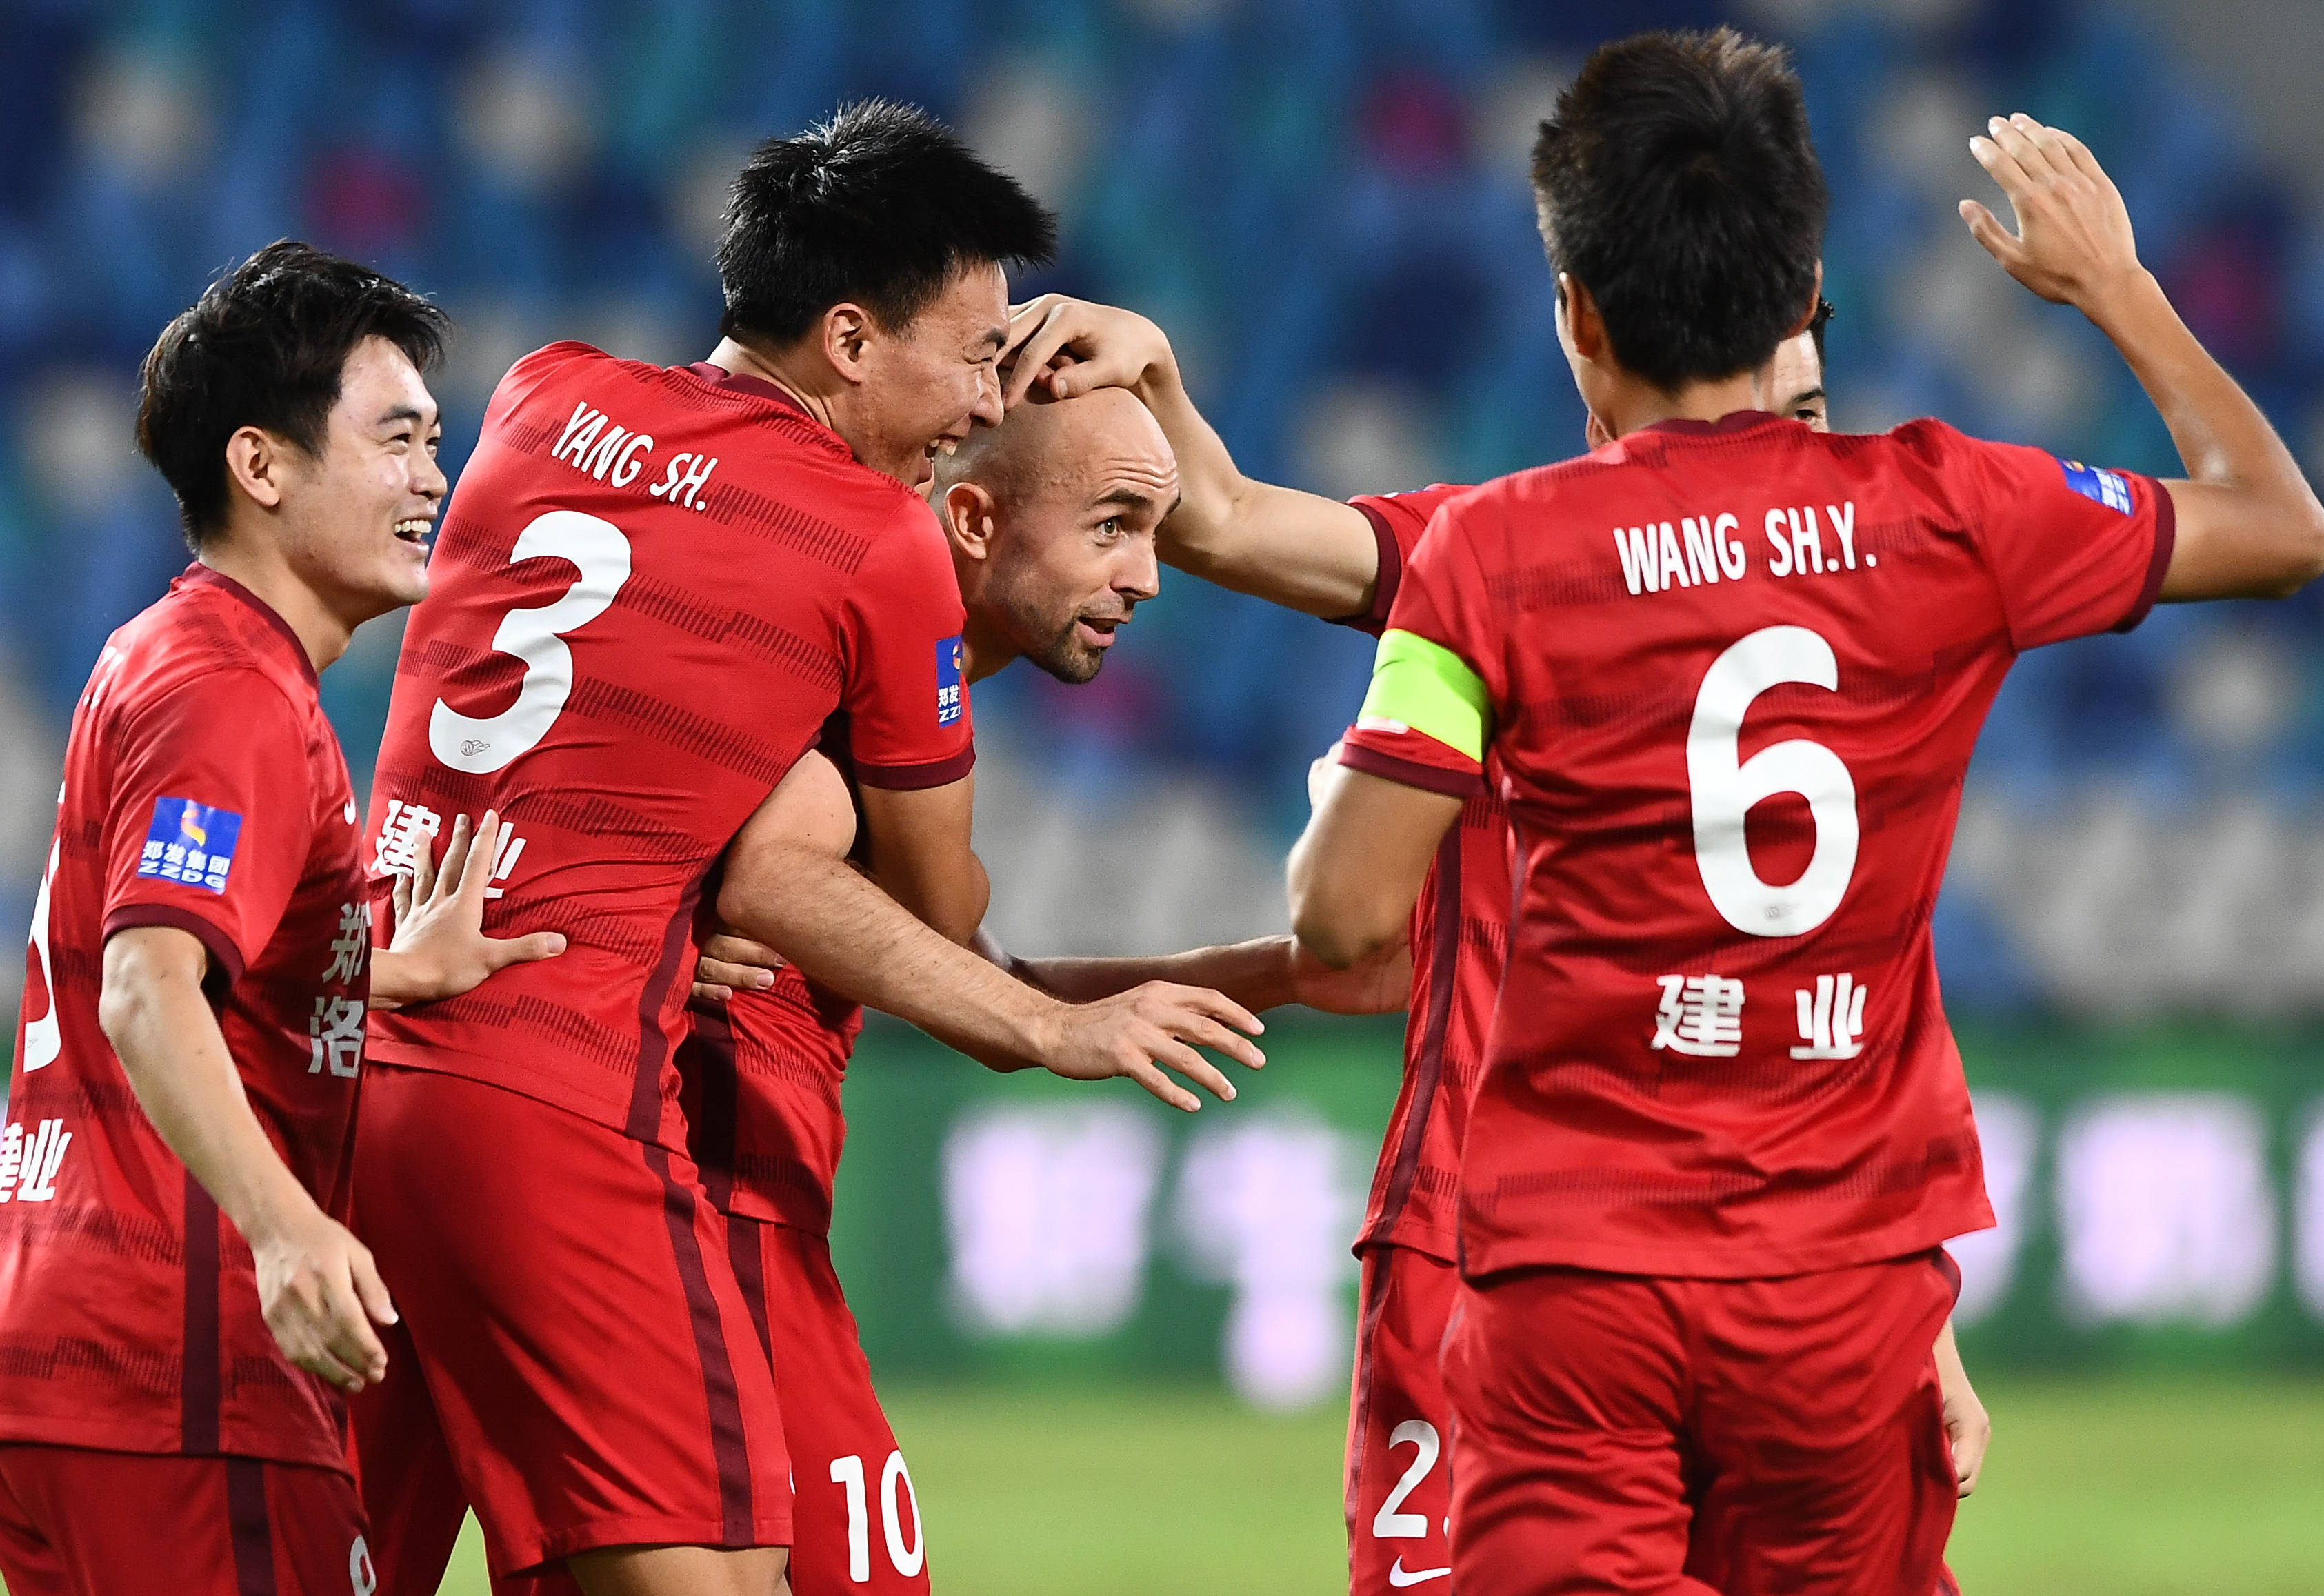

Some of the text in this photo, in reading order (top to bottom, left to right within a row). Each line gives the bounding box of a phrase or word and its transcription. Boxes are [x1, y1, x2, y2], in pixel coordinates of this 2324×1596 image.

[551, 401, 719, 512] YANG SH.
[1613, 501, 1877, 596] WANG SH.Y.
[429, 510, 632, 774] 3
[1686, 625, 1860, 938] 6
[137, 860, 227, 889] ZZDG
[141, 839, 231, 876] 郑发集团
[1650, 972, 1867, 1060] 建业
[830, 1449, 925, 1583] 10
[1372, 1419, 1450, 1539] 2
